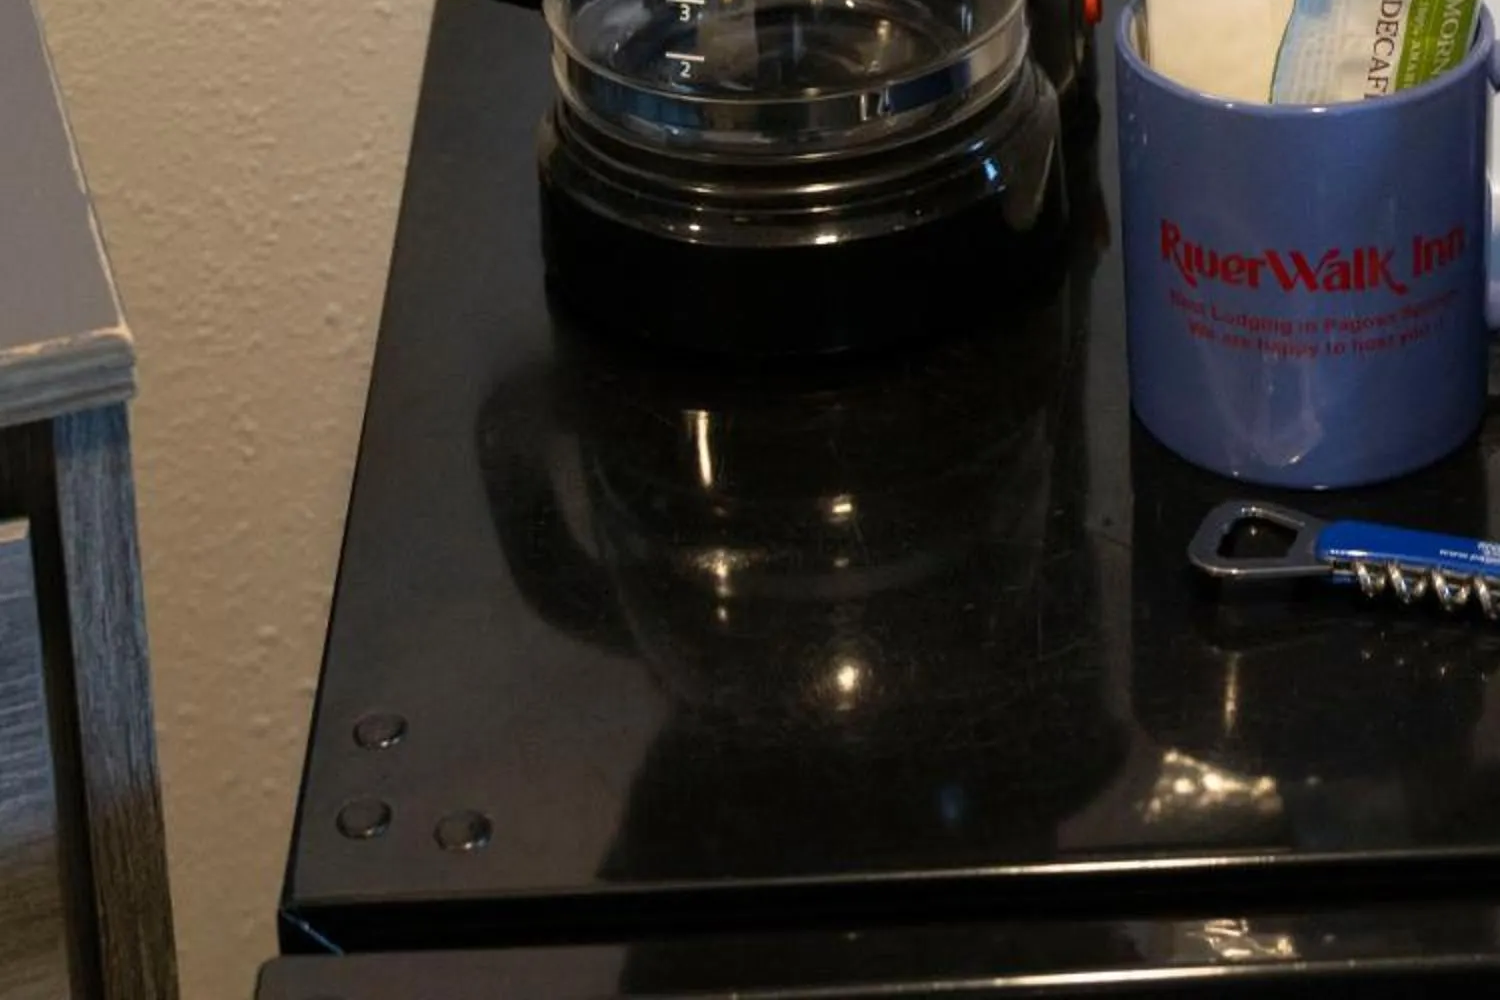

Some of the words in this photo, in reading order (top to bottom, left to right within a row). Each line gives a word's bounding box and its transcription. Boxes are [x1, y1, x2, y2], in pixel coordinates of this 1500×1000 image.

[679, 4, 691, 22] 3
[679, 61, 692, 79] 2
[1159, 218, 1408, 296] RiverWalk
[1412, 226, 1466, 279] Inn
[1298, 319, 1318, 334] in
[1324, 312, 1398, 336] Pagosa
[1221, 331, 1252, 349] are
[1257, 335, 1319, 359] happy
[1326, 340, 1346, 355] to
